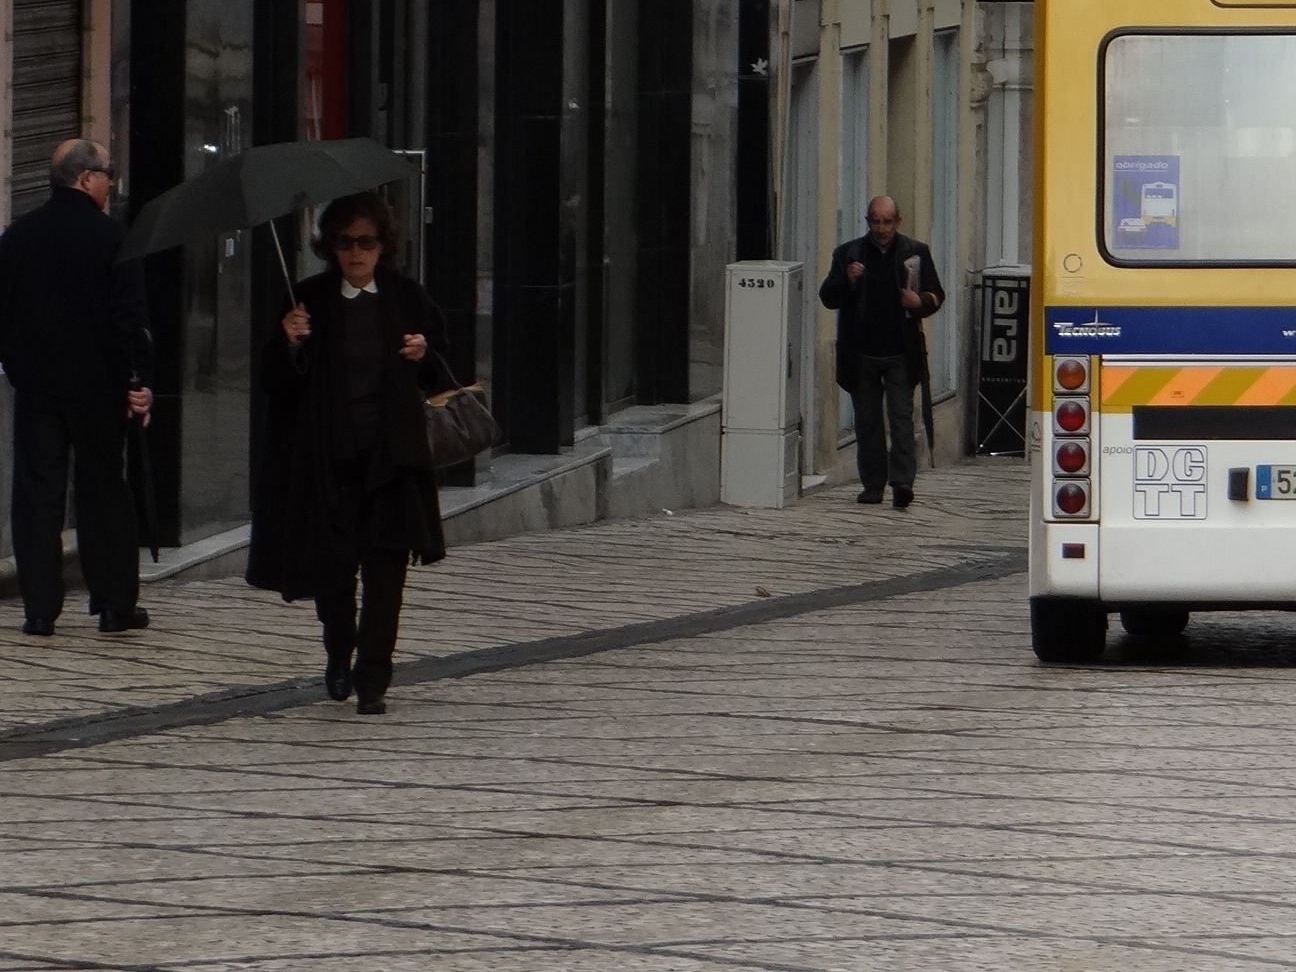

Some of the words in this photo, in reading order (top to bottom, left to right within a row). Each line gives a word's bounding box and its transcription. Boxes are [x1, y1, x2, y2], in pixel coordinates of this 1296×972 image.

[1116, 161, 1169, 170] obrigado
[1103, 445, 1133, 455] apoio
[1135, 484, 1205, 517] TT
